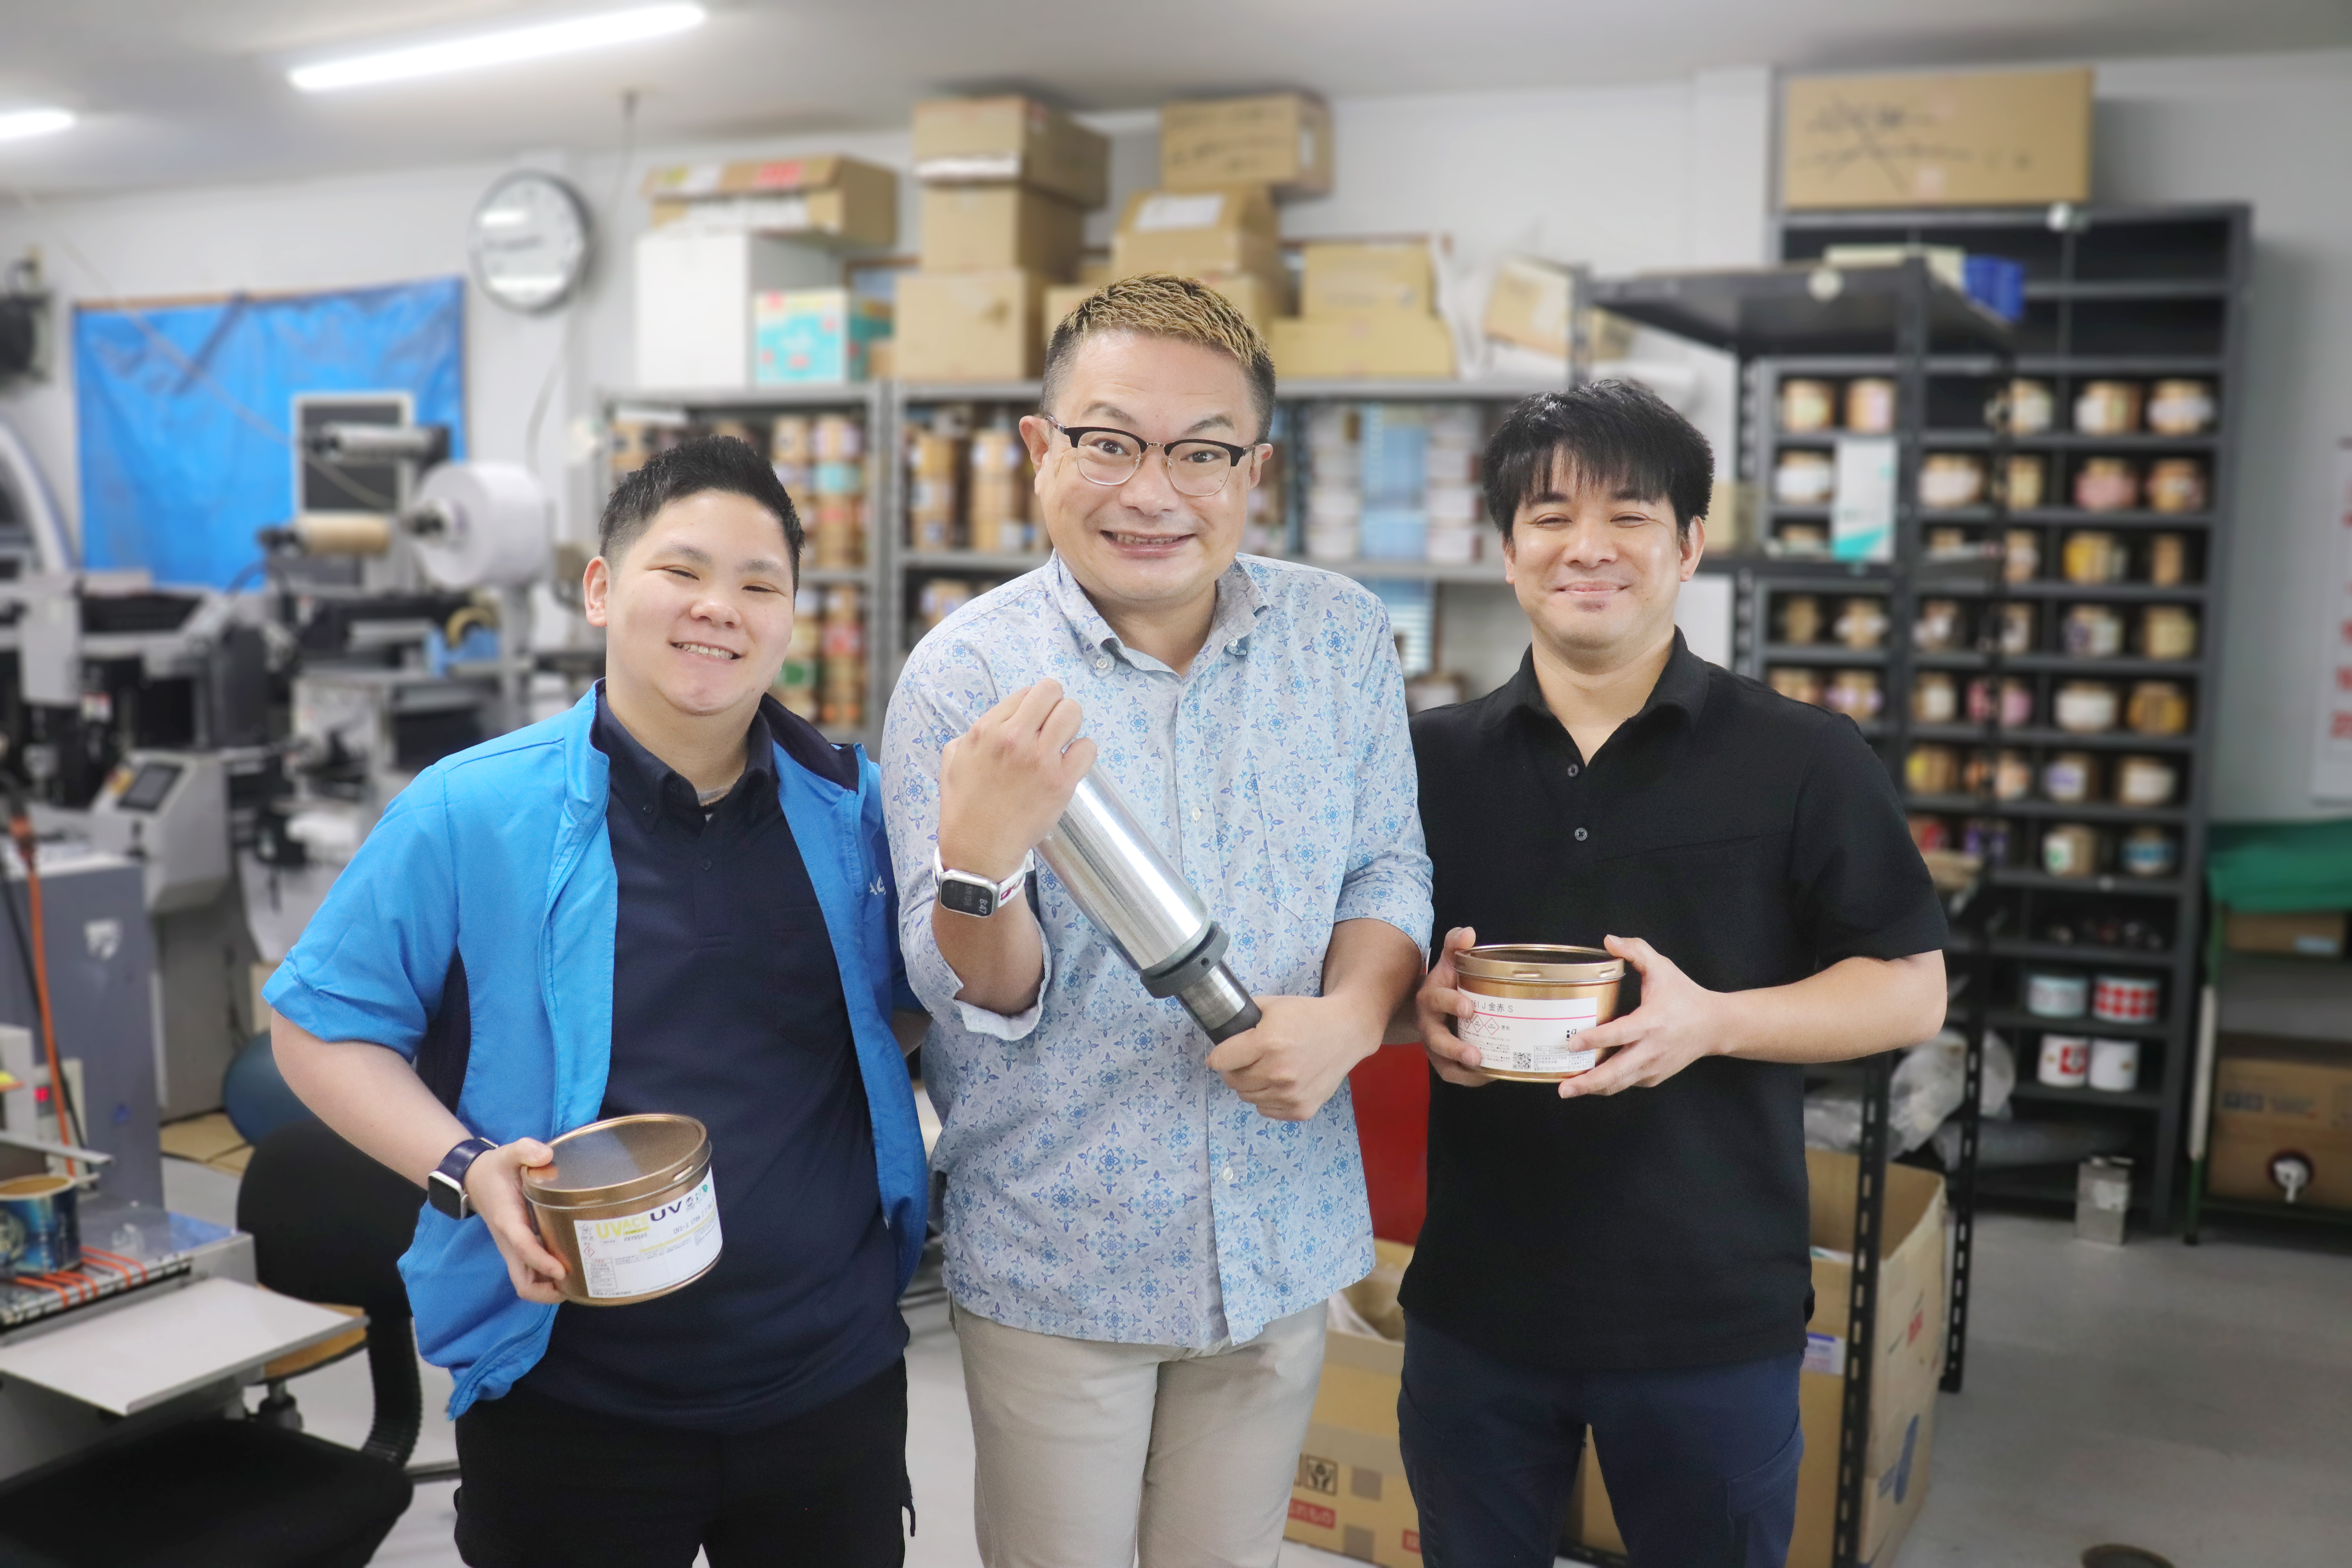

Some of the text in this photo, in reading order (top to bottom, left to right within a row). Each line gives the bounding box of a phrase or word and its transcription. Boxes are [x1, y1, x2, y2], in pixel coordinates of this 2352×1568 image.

[979, 898, 987, 914] 8:47
[1488, 1002, 1504, 1013] 金赤
[650, 1200, 682, 1221] UV
